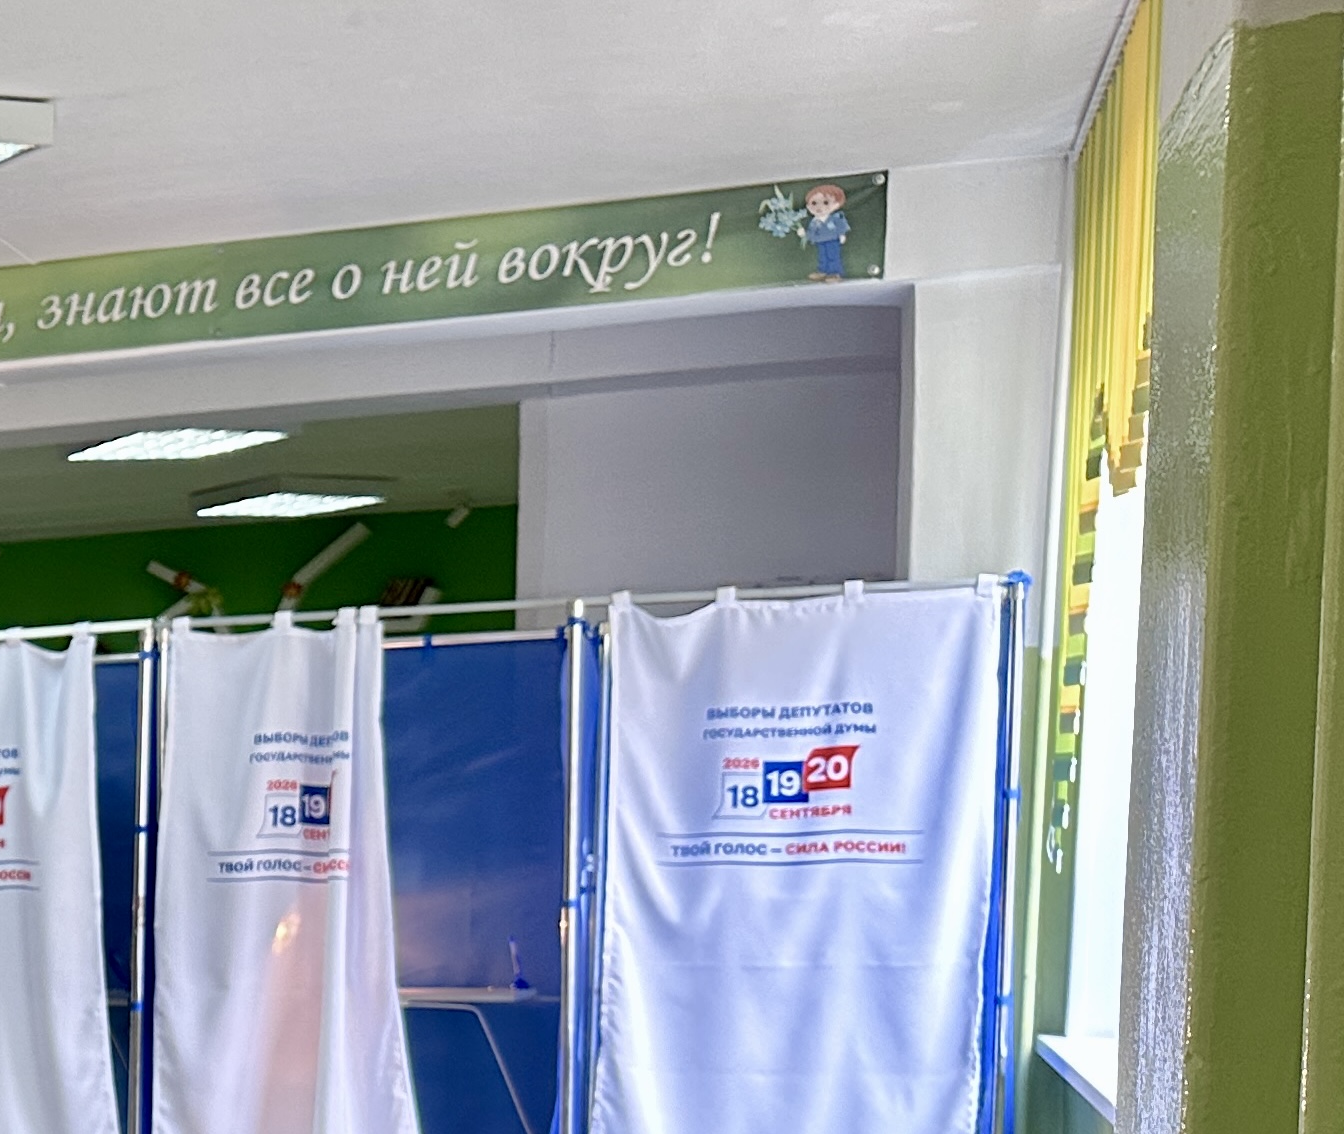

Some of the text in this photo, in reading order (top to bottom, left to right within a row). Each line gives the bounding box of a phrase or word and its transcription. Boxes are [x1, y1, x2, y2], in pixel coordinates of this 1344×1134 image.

[36, 278, 219, 330] знают
[235, 267, 315, 310] все
[331, 263, 362, 300] о
[381, 239, 479, 294] ней
[498, 211, 721, 294] вокруг!
[707, 701, 873, 720] ВЫБОРЫ ДЕПУТАТОВ
[254, 731, 308, 746] ВЫБОРЫ
[703, 723, 876, 740] ГОСУДАРСТВЕННОЙ ДУМЫ
[722, 757, 760, 770] 2026
[727, 754, 848, 809] 18 19 20
[269, 793, 326, 827] 18 19
[768, 804, 852, 820] СЕНТЯБРЯ
[670, 841, 712, 857] ТВОЙ
[714, 842, 767, 857] ГОЛОС
[785, 841, 828, 856] СИЛА
[834, 840, 906, 855] РОССИИ!
[218, 858, 253, 873] ТВОЙ
[257, 858, 302, 872] ГОЛОС
